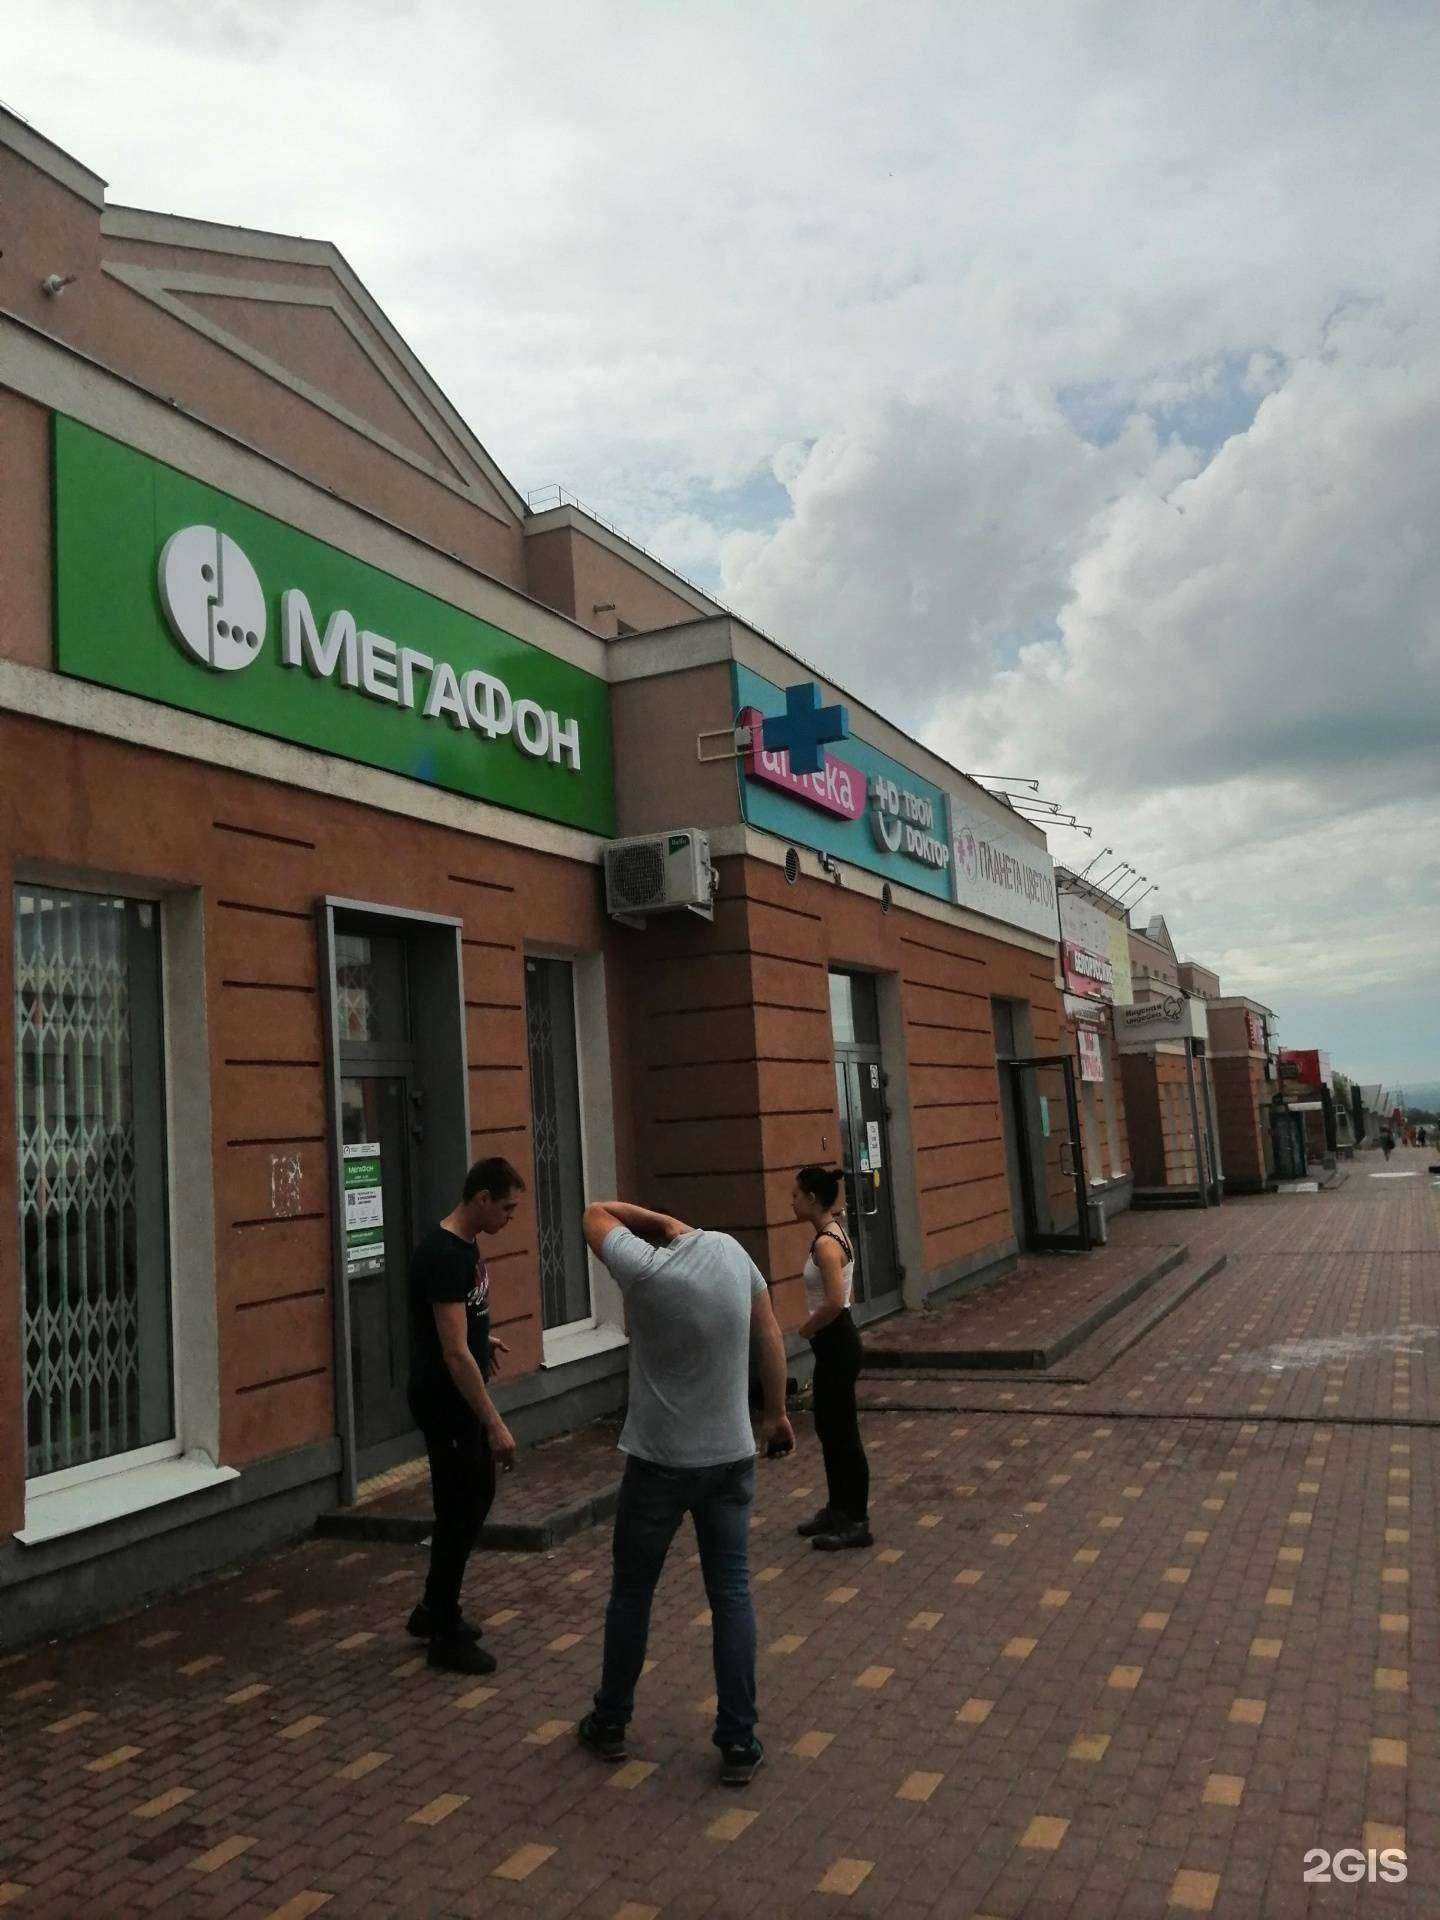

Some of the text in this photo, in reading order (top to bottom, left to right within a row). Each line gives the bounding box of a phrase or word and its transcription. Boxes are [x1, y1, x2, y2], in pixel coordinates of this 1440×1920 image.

[281, 588, 580, 771] МЕГАФОН
[761, 750, 855, 811] аека
[979, 841, 1023, 895] ПЛАНЕТА
